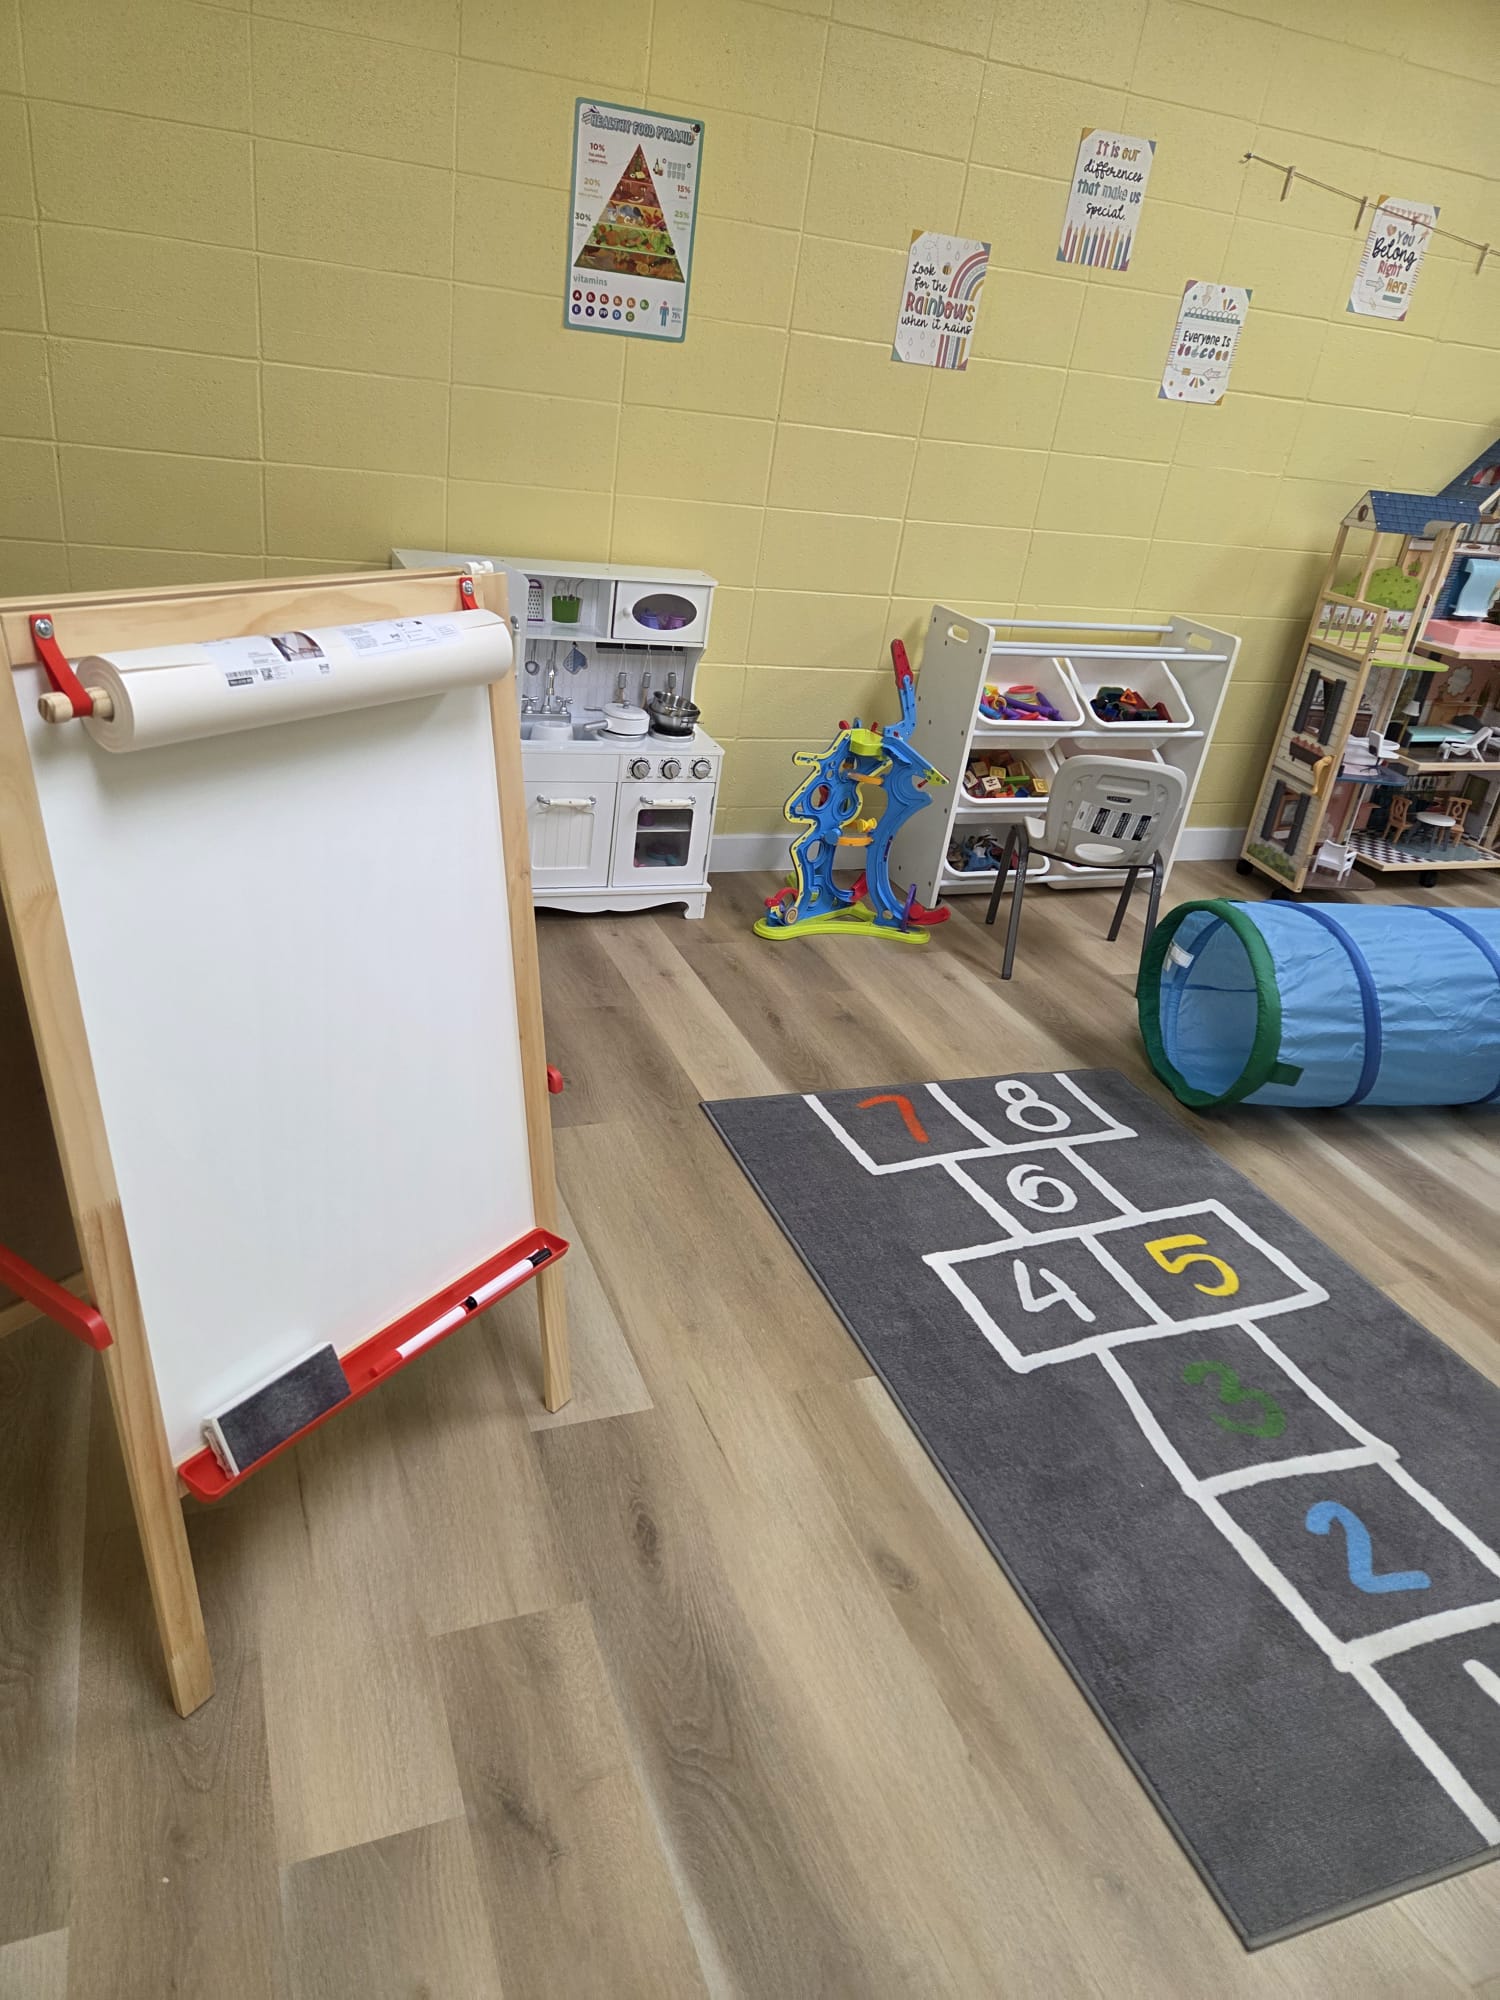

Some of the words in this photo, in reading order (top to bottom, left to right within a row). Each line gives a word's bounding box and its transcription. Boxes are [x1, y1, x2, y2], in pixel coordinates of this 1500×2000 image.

[590, 113, 632, 134] HEALTHY
[632, 121, 656, 138] FOOD
[655, 126, 695, 145] PYRAMID
[589, 142, 605, 152] 10%
[1096, 140, 1110, 157] It
[1110, 140, 1120, 158] is
[1122, 147, 1141, 162] our
[1083, 158, 1143, 183] differences
[584, 177, 601, 187] 20%
[677, 184, 691, 194] 15%
[1077, 178, 1100, 196] that
[1102, 184, 1128, 202] make
[1129, 190, 1141, 204] us
[575, 212, 591, 222] 30%
[674, 211, 690, 220] 25%
[1372, 236, 1418, 272] Belong
[573, 273, 608, 287] vitamins
[912, 261, 936, 277] Look
[1377, 260, 1403, 278] Right
[914, 275, 930, 292] for
[931, 279, 948, 293] the
[1386, 278, 1408, 294] Here
[905, 291, 976, 323] Rainbows
[900, 315, 929, 330] when
[931, 318, 942, 331] it
[942, 322, 972, 335] rains
[1183, 330, 1220, 347] Everyone
[1221, 336, 1232, 348] Is
[996, 1079, 1071, 1133] 8
[856, 1095, 929, 1144] 7
[1006, 1164, 1078, 1214] 6
[1144, 1234, 1240, 1297] 5
[1012, 1258, 1096, 1322] 4
[1183, 1360, 1286, 1438] 3
[1305, 1501, 1431, 1594] 2
